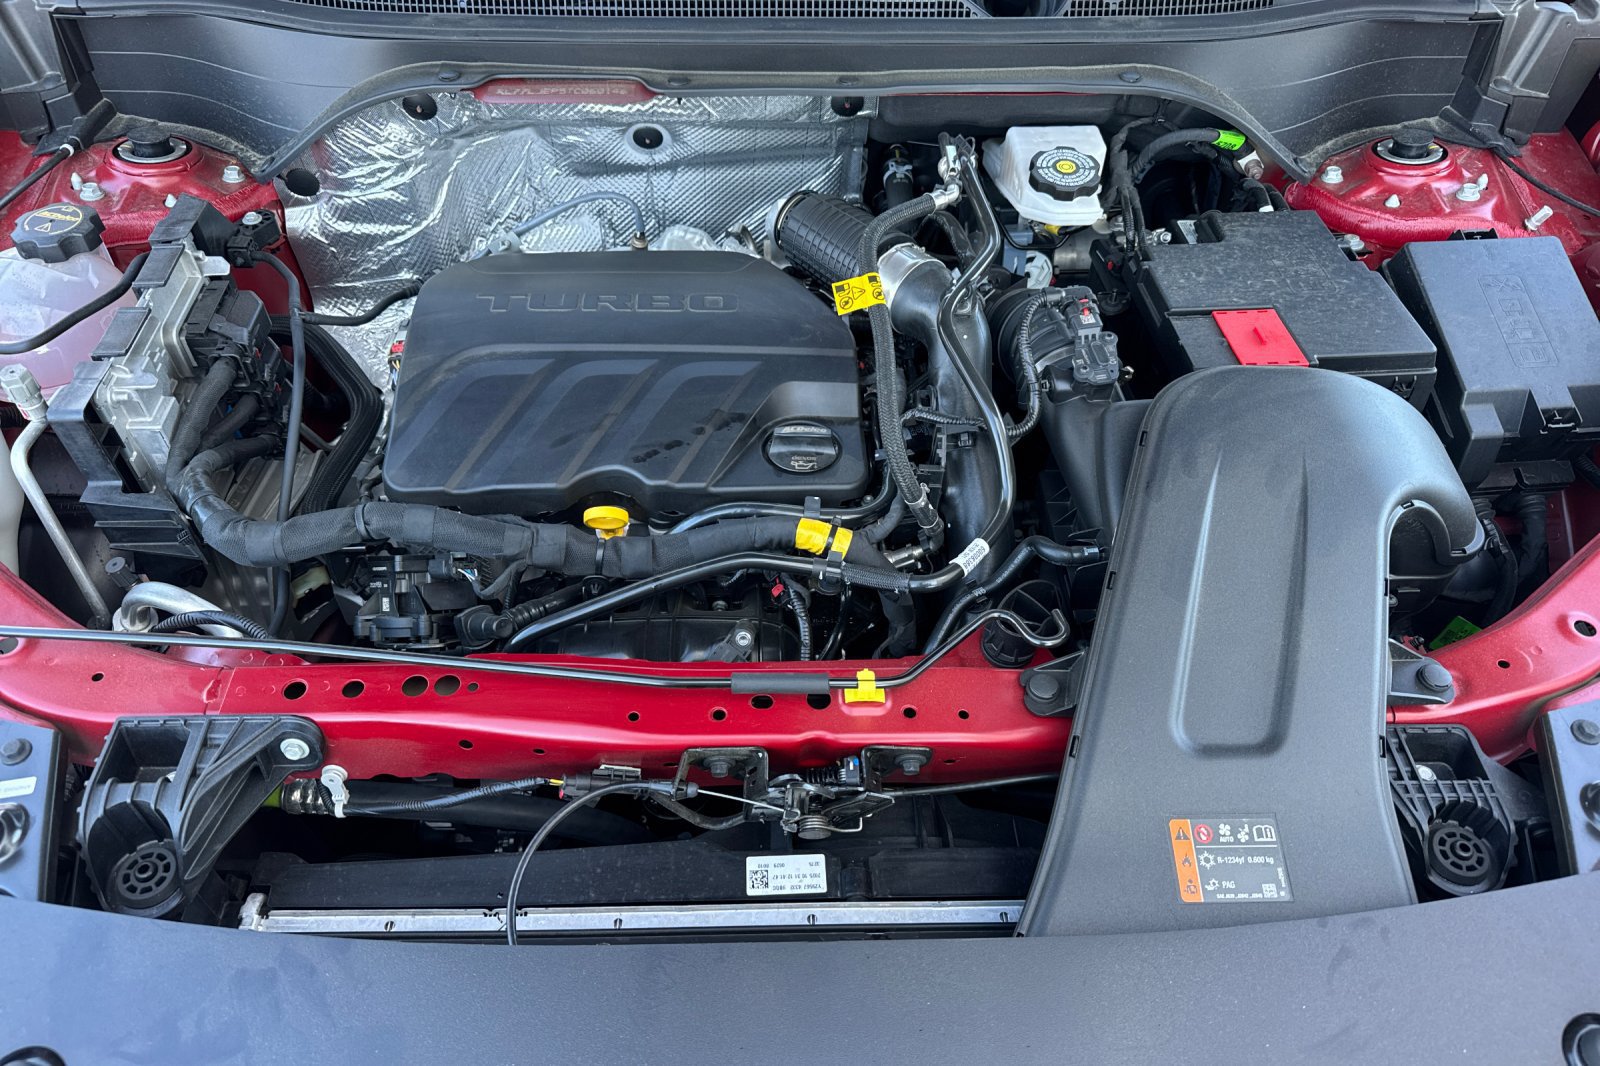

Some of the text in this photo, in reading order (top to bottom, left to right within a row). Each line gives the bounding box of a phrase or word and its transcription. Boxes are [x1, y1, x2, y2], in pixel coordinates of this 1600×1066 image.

[475, 293, 739, 313] TURBO
[1217, 856, 1245, 865] R-1234yf
[1265, 856, 1275, 866] kg
[1221, 880, 1236, 889] PAG
